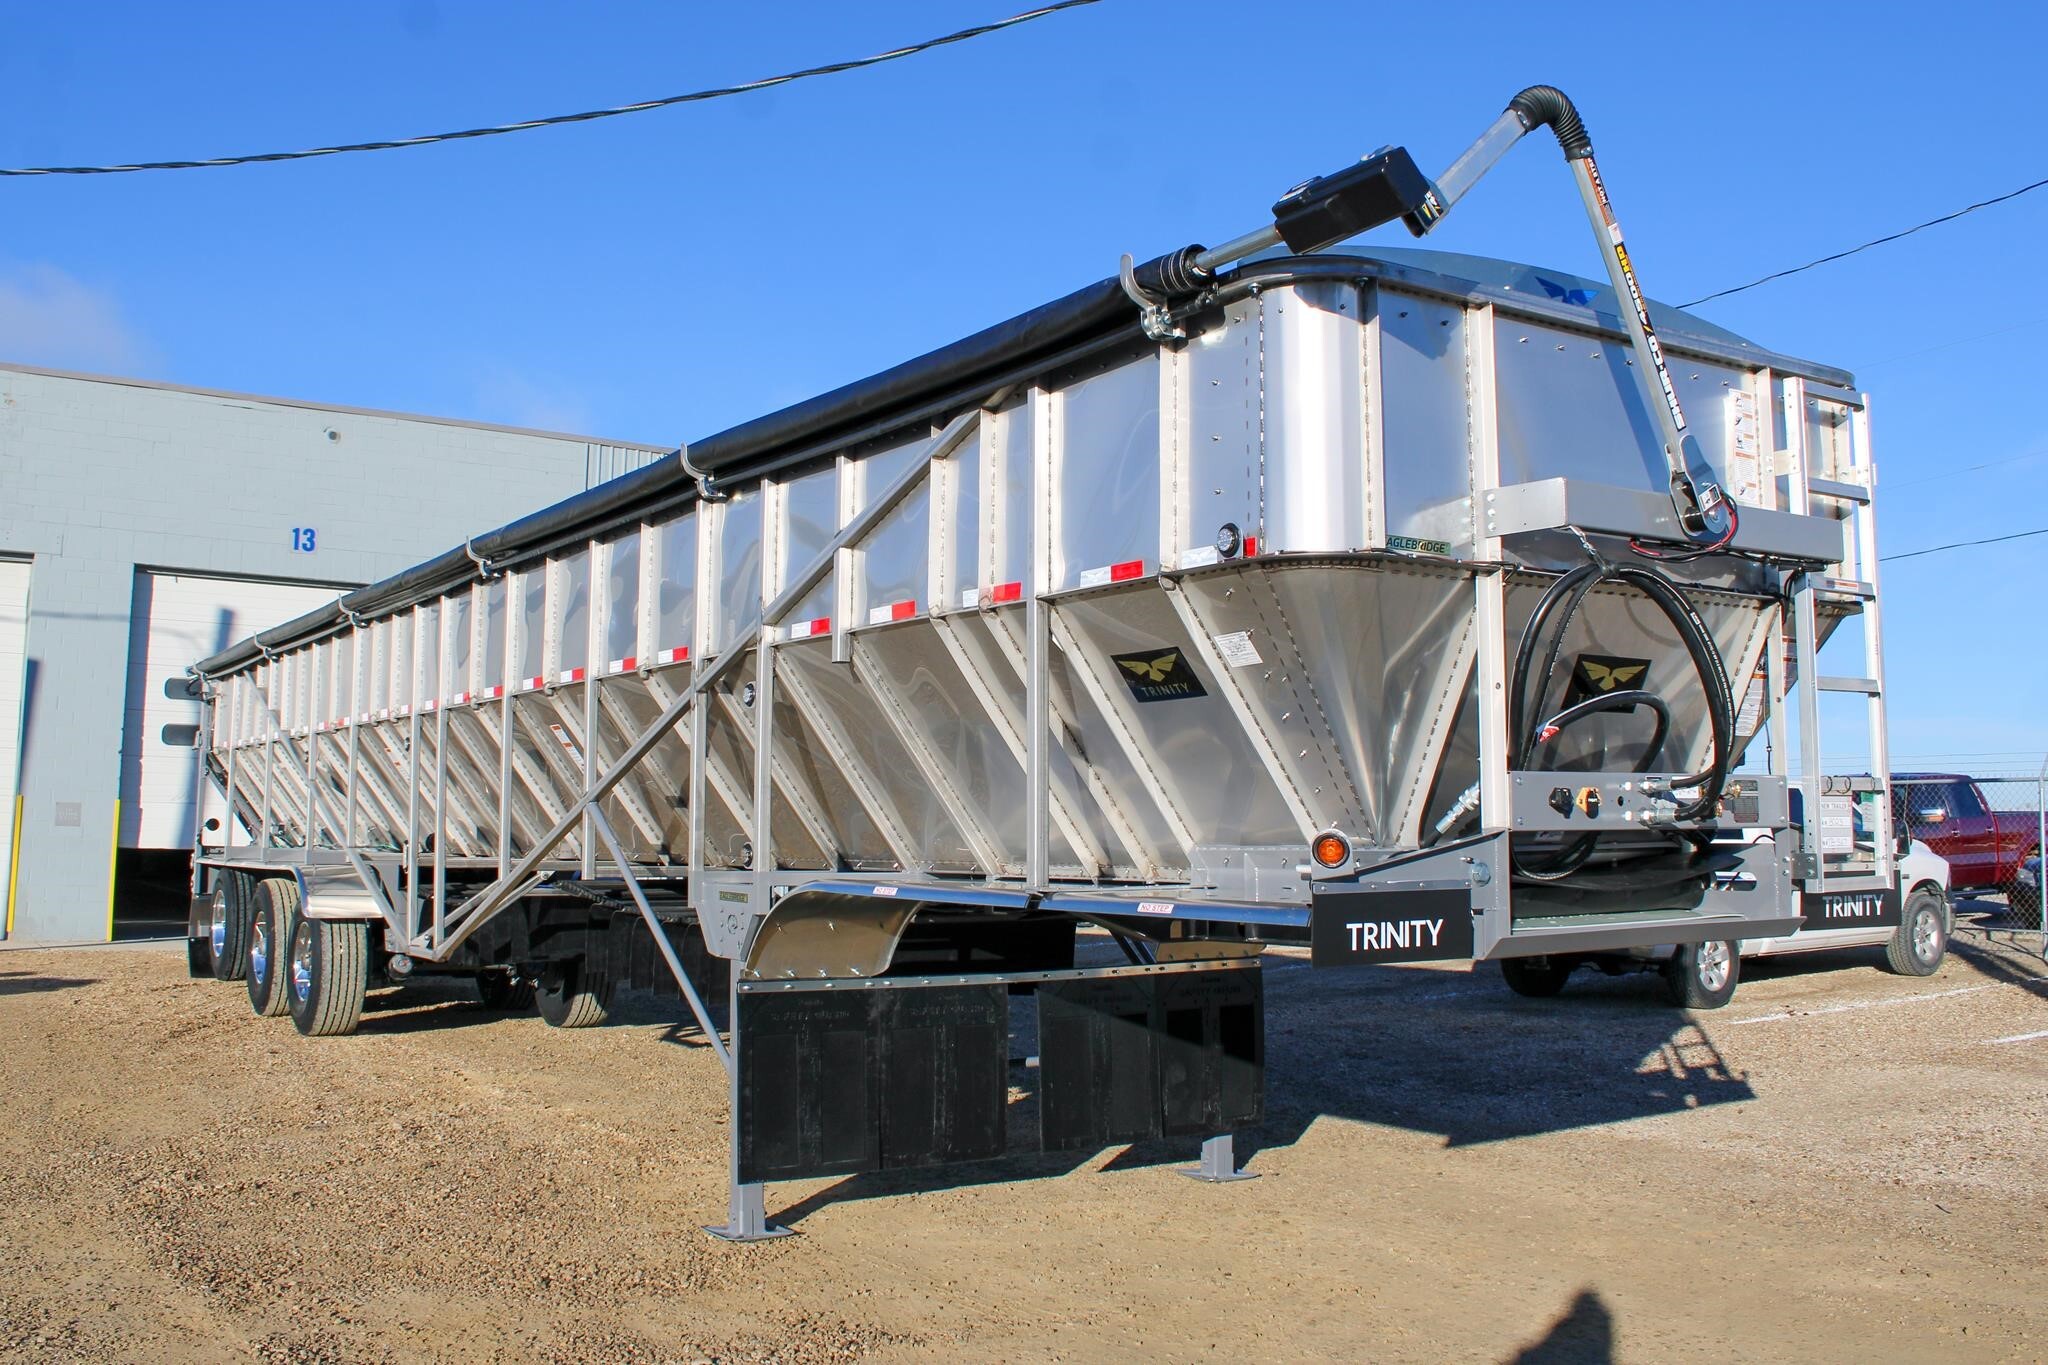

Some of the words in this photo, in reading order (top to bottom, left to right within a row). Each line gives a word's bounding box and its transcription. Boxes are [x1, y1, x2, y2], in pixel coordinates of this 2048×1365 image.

[1616, 245, 1648, 326] 4500HD
[1648, 335, 1686, 431] SHUR-CO
[292, 527, 316, 552] 13
[1386, 537, 1446, 553] AGLEBRIDGE
[1141, 682, 1189, 697] TRINITY
[1822, 894, 1884, 918] TRINITY
[1345, 919, 1444, 951] TRINITY
